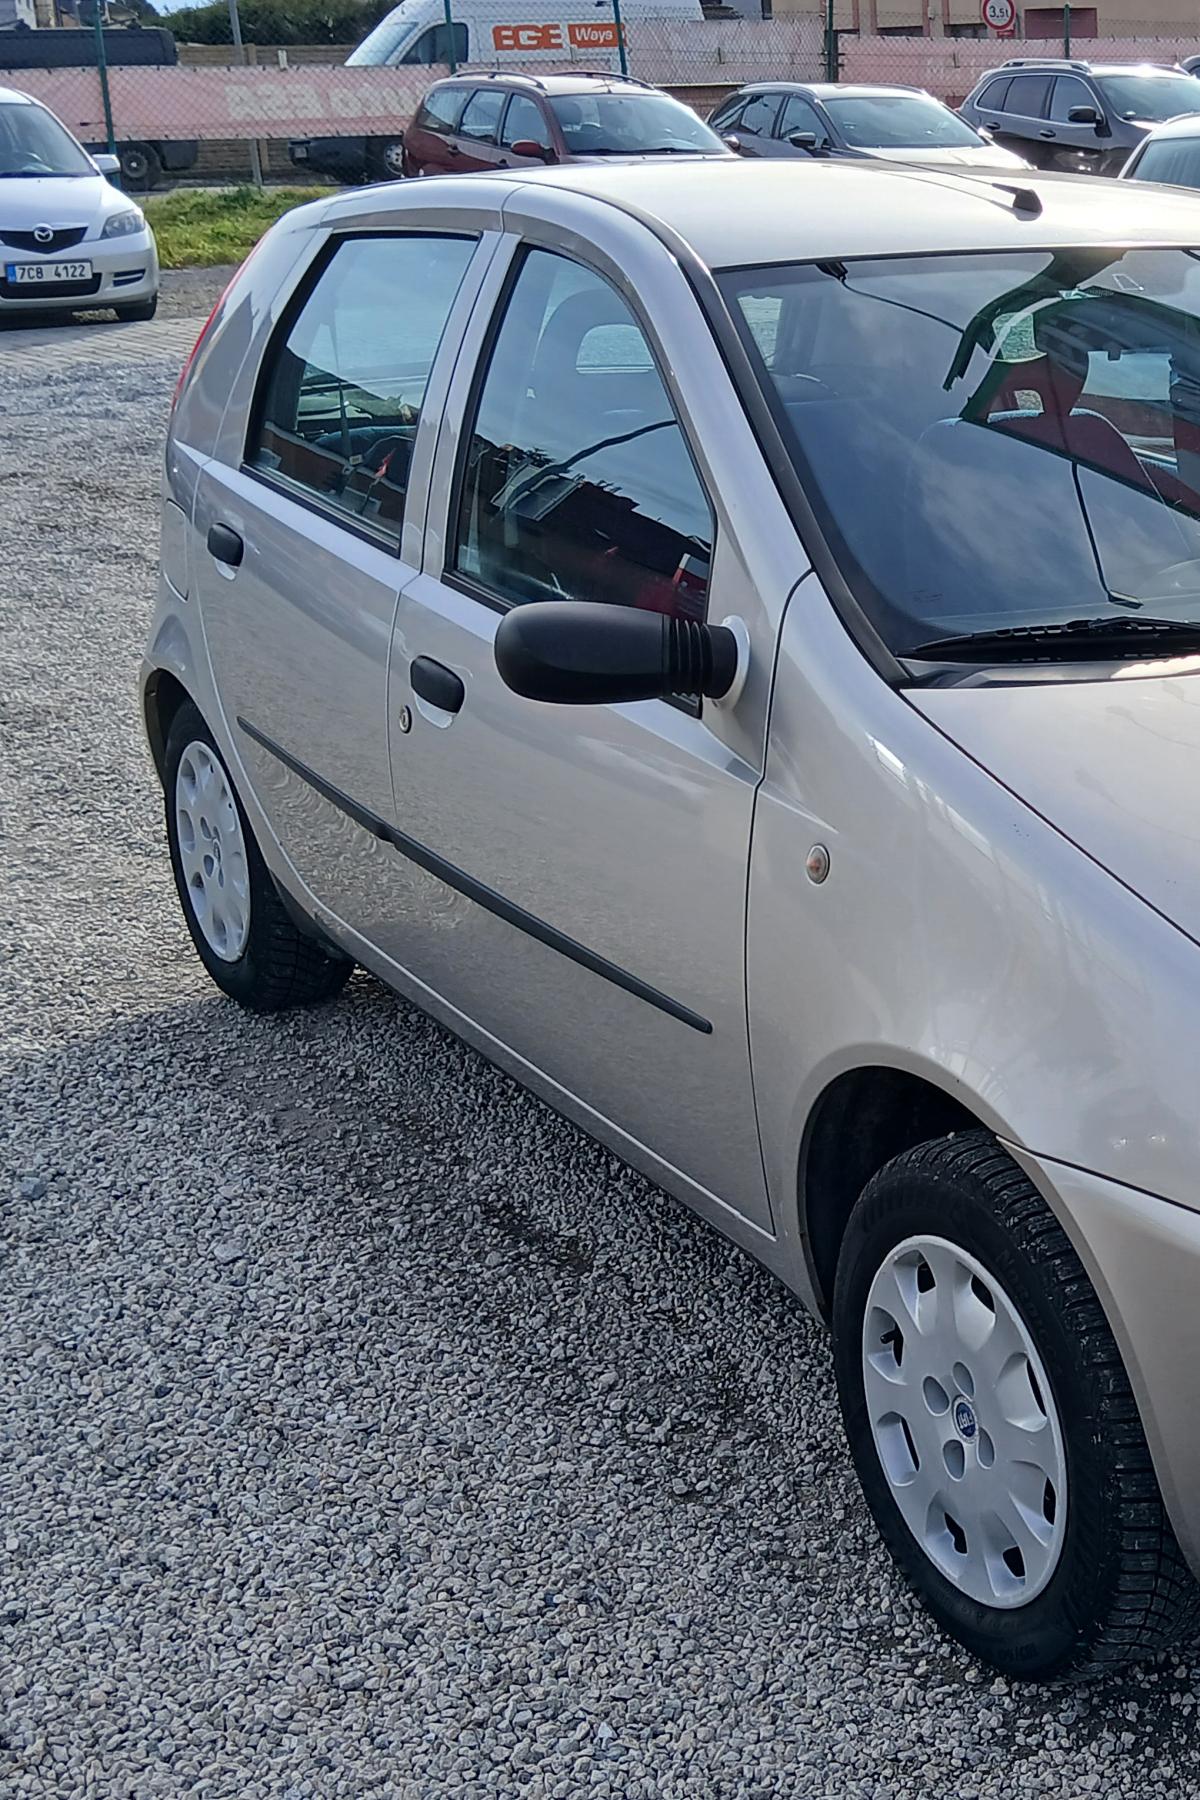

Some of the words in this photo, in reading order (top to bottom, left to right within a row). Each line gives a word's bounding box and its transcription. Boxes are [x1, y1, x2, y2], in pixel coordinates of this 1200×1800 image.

[492, 24, 563, 51] EGE
[575, 27, 613, 44] Ways
[54, 264, 86, 278] 4122
